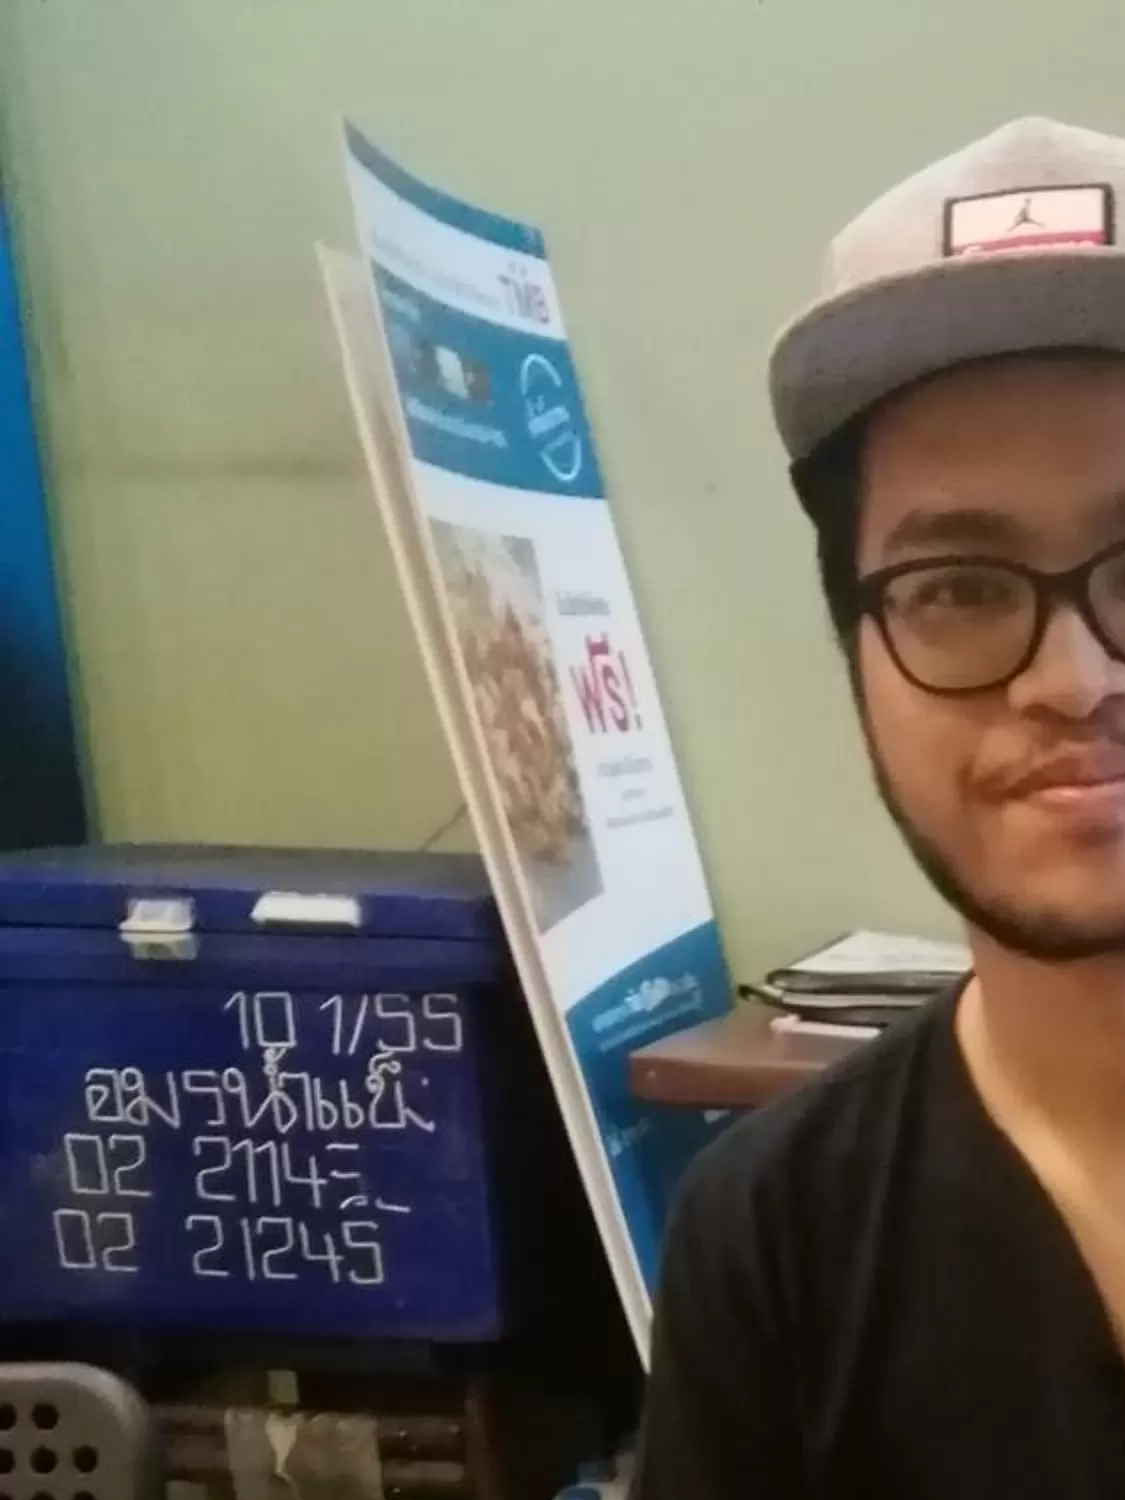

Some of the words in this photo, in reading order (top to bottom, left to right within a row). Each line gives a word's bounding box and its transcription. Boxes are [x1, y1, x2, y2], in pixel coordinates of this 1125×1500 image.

[224, 991, 296, 1050] 10
[319, 993, 462, 1055] 1/55
[65, 1133, 152, 1197] 02
[53, 1209, 139, 1272] 02
[186, 1214, 384, 1285] 21245
